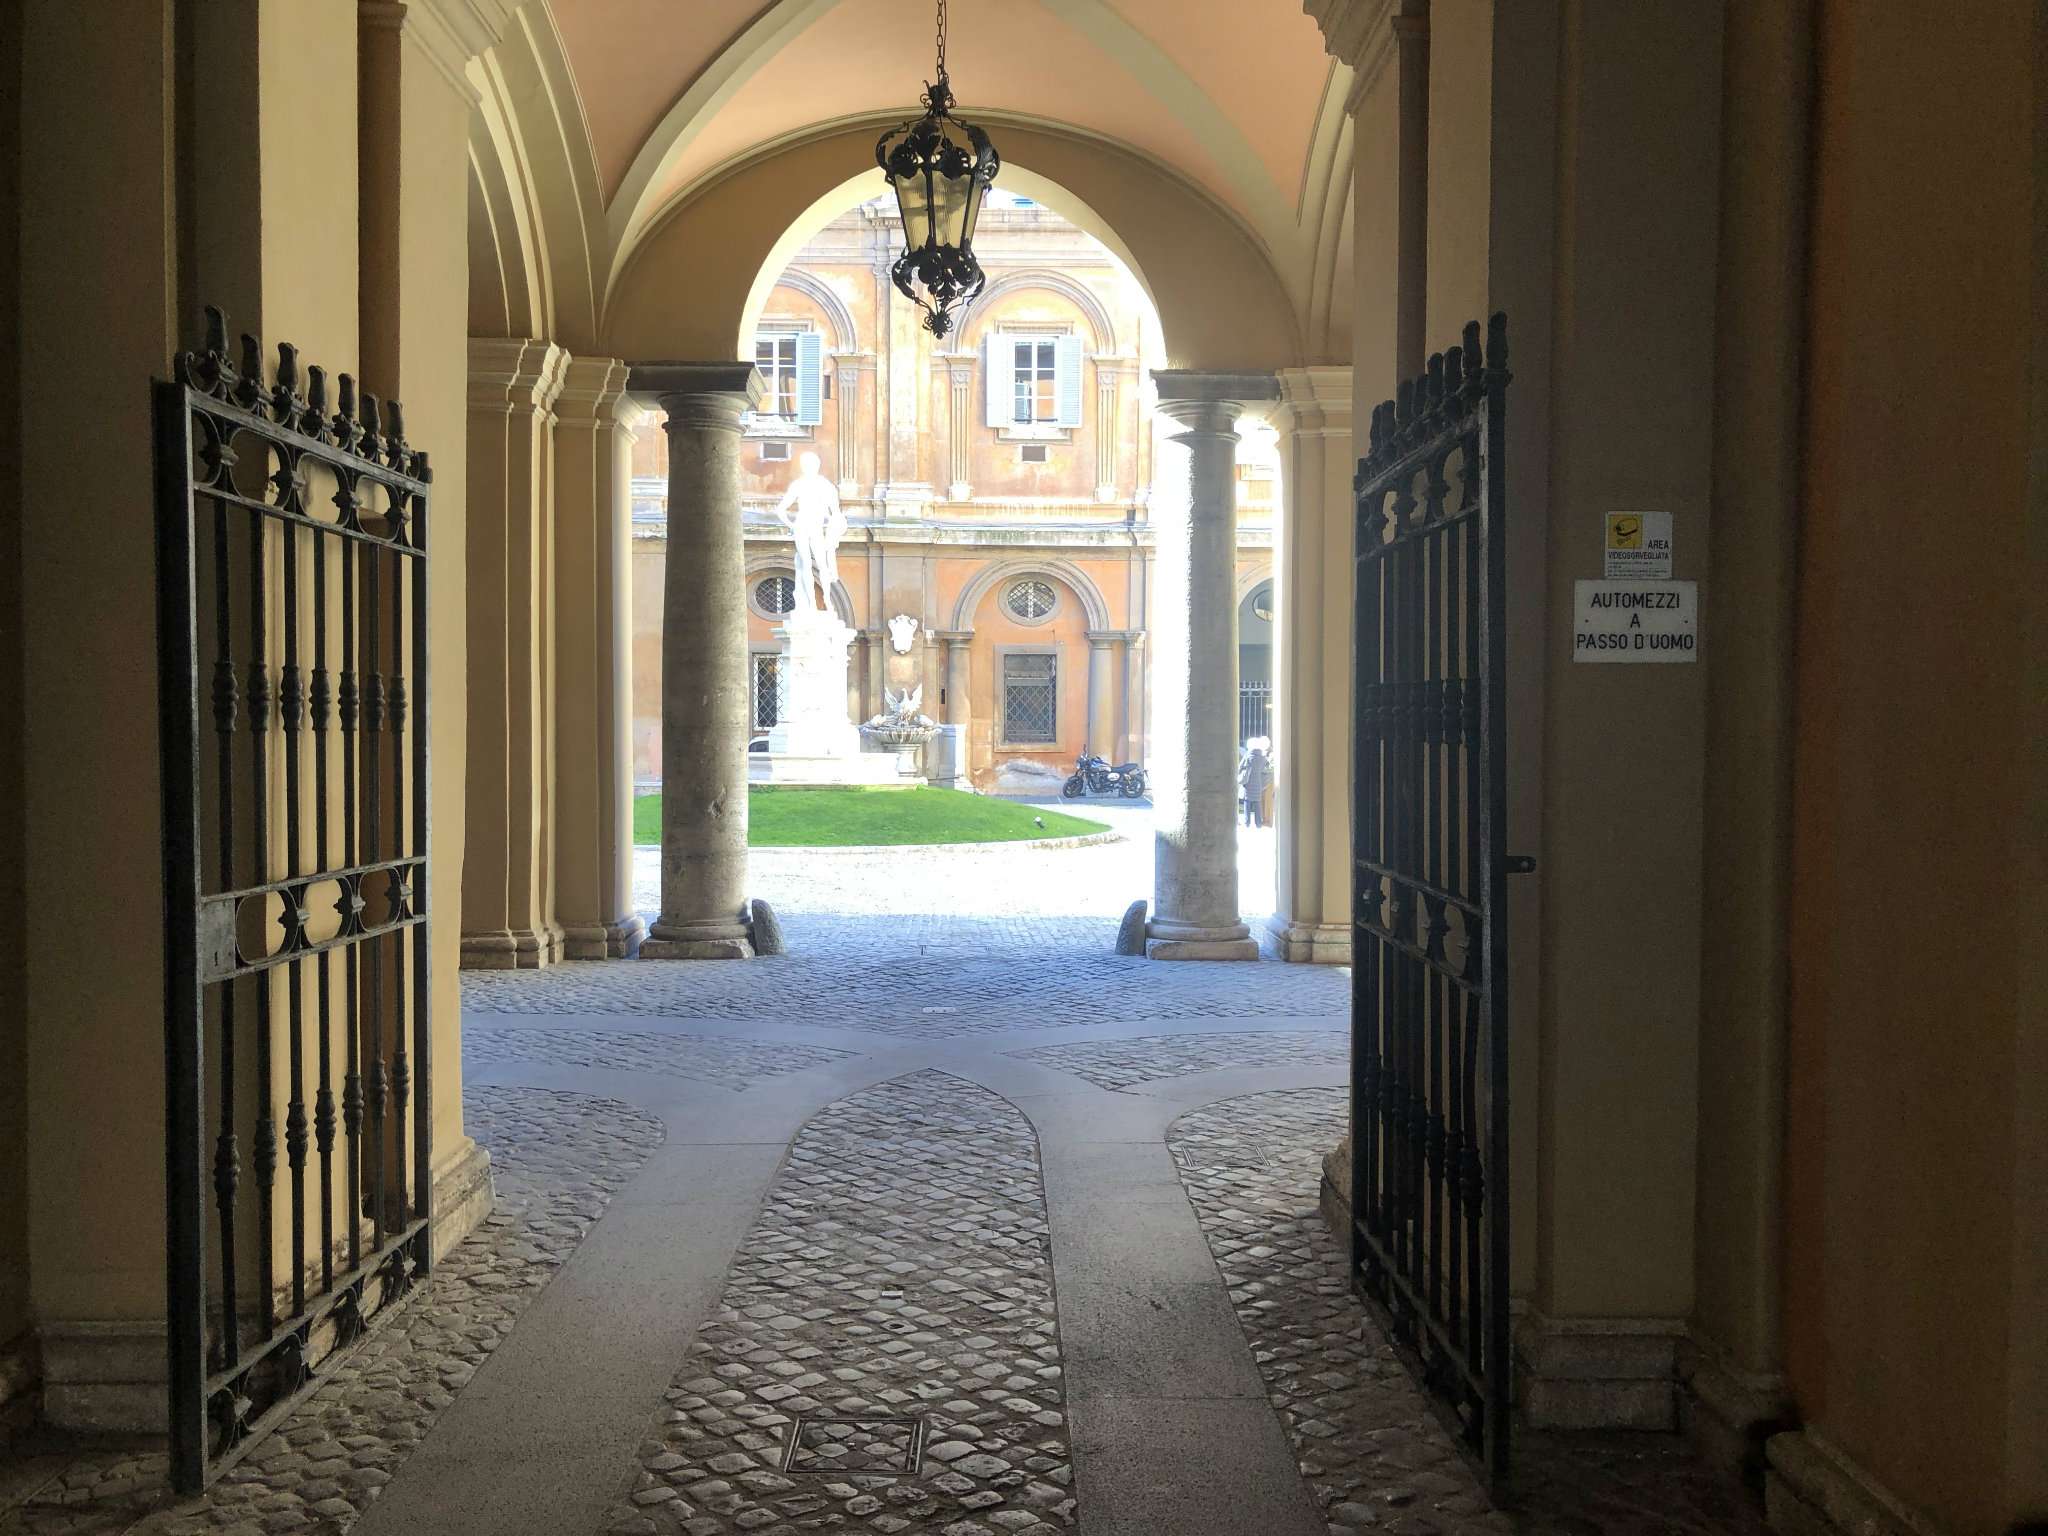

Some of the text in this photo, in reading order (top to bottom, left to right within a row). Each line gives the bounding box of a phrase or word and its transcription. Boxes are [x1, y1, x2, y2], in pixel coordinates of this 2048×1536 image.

[1647, 539, 1670, 550] AREA
[1607, 551, 1670, 560] VIDEOSORVEGLIATA
[1590, 592, 1680, 609] AUTOMEZZI
[1629, 612, 1641, 628] A
[1576, 633, 1628, 649] PASSO
